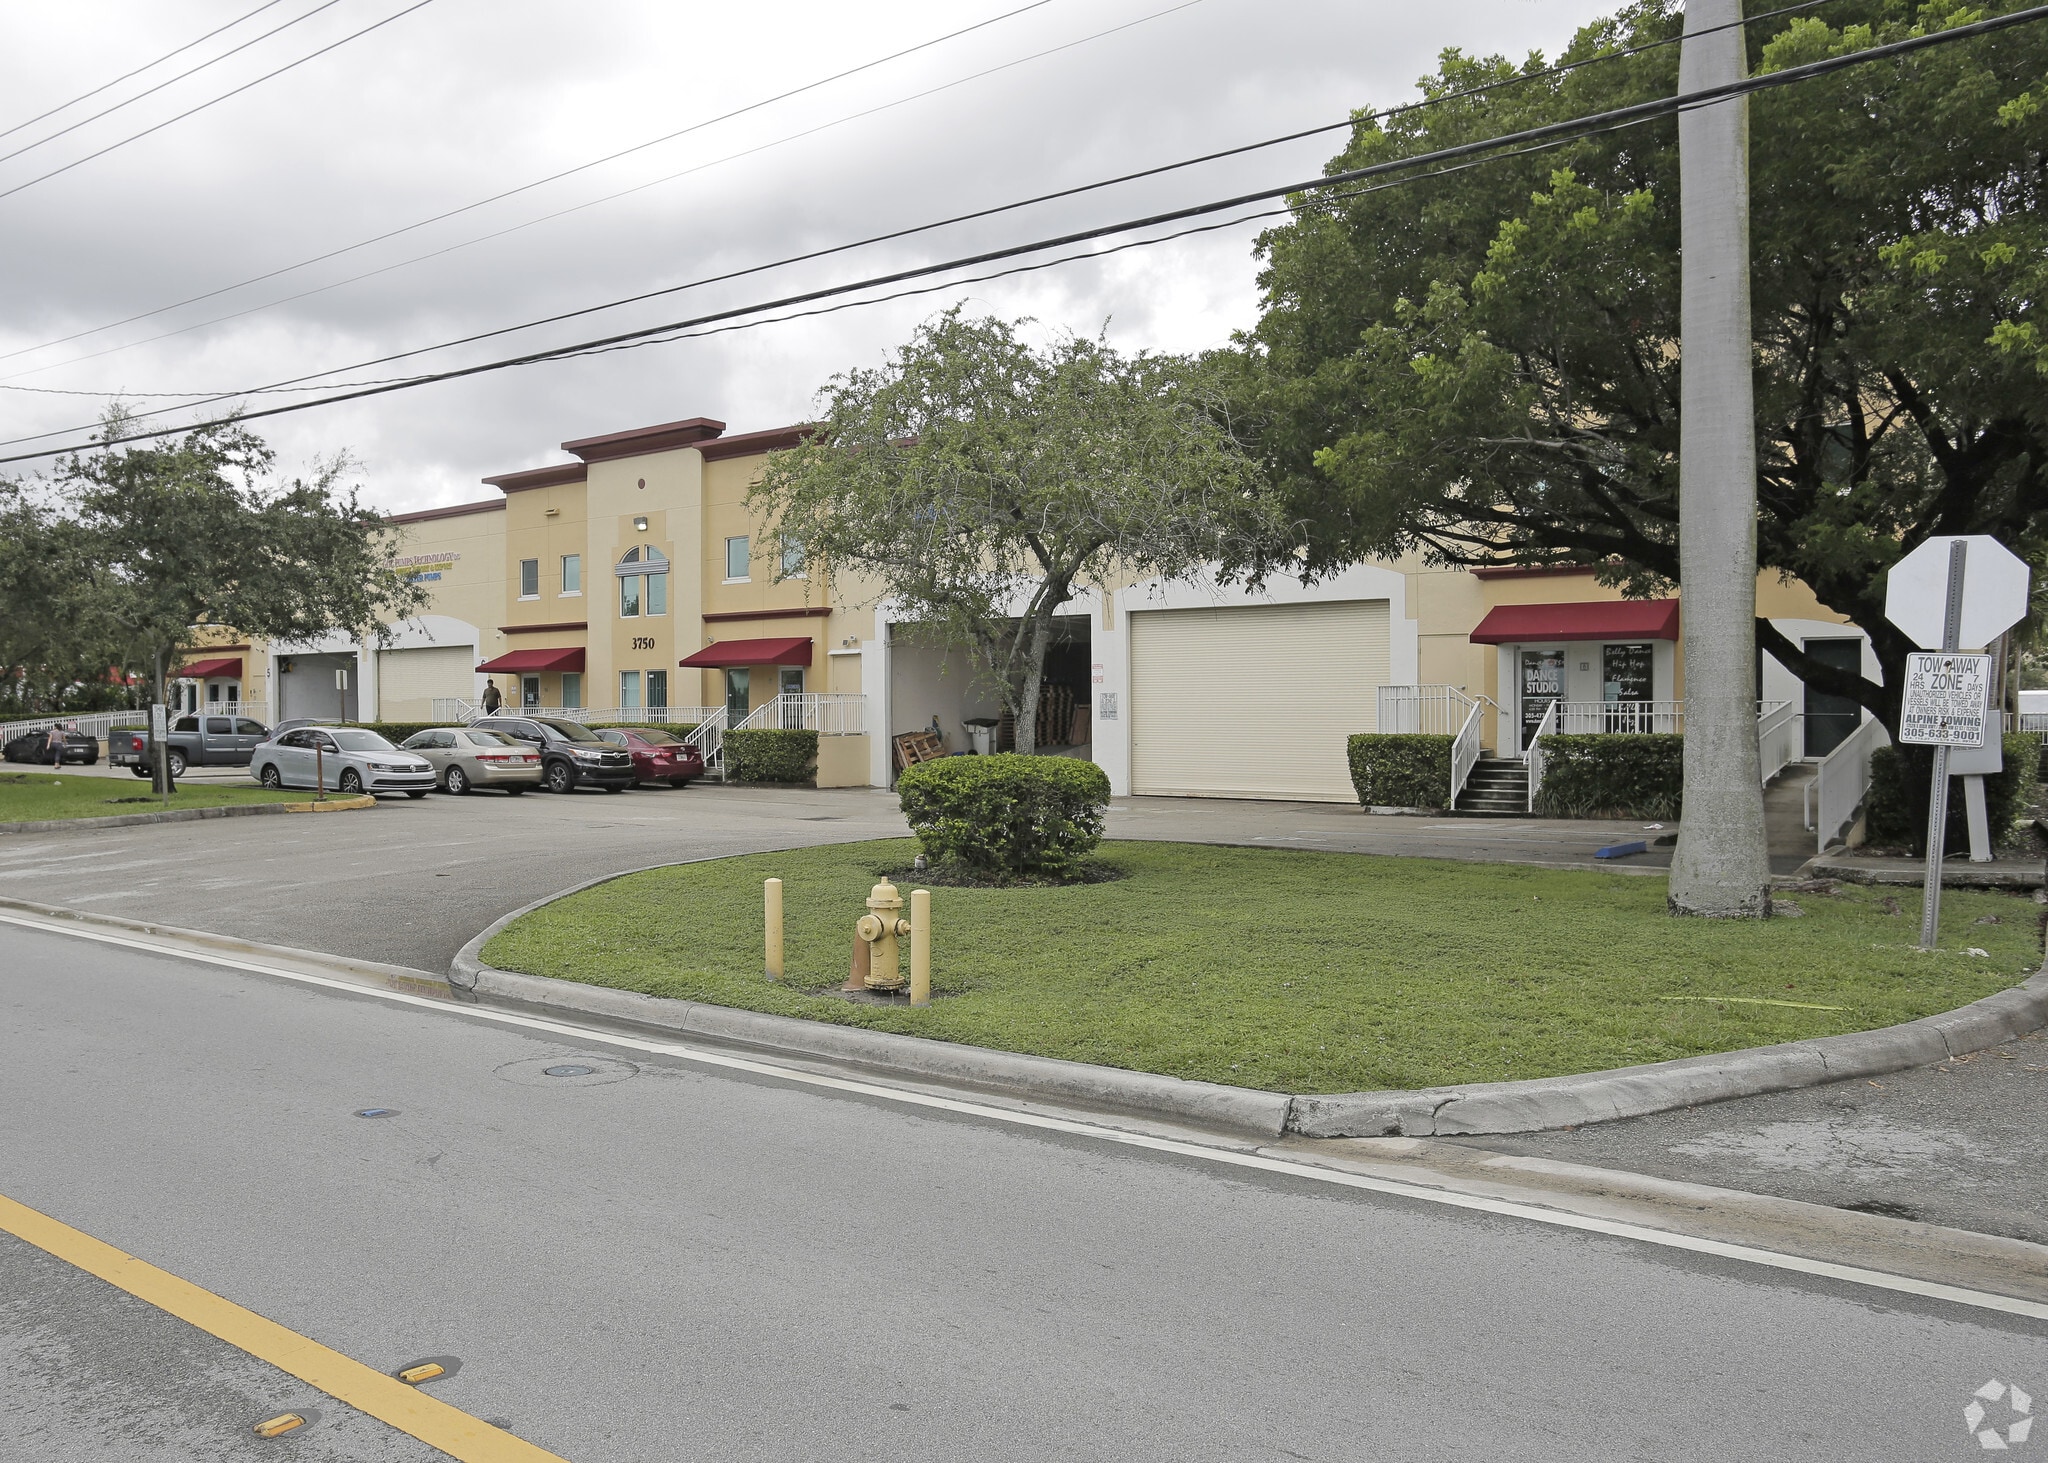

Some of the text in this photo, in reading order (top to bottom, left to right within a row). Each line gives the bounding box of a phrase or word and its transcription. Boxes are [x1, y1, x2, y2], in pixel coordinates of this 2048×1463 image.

[414, 552, 454, 565] TECHNOLOGY
[631, 637, 655, 650] 3750
[1606, 647, 1626, 657] Belly
[1612, 659, 1646, 669] Hip Hop
[1918, 656, 1980, 674] TOW AWAY
[266, 668, 271, 678] 5
[1527, 669, 1558, 681] DANCE
[1910, 681, 1983, 691] HRS DAYS
[1913, 672, 1980, 690] 24 ZONE 7
[1526, 682, 1559, 693] STUDIO
[1619, 688, 1639, 696] Salsa
[1910, 689, 1981, 700] UNAUTHORIZED VEHICLES OR
[1907, 697, 1929, 707] VESSELS
[1929, 699, 1941, 707] WILL
[1943, 699, 1949, 707] BE
[1951, 699, 1968, 708] TOWED
[1916, 706, 1936, 715] OWNERS
[1937, 707, 1950, 715] RISK
[1951, 708, 1955, 716] &
[1957, 708, 1980, 717] EXPENSE
[1905, 714, 1981, 727] ALPINE TOWING
[1904, 728, 1980, 740] 305-633-9001
